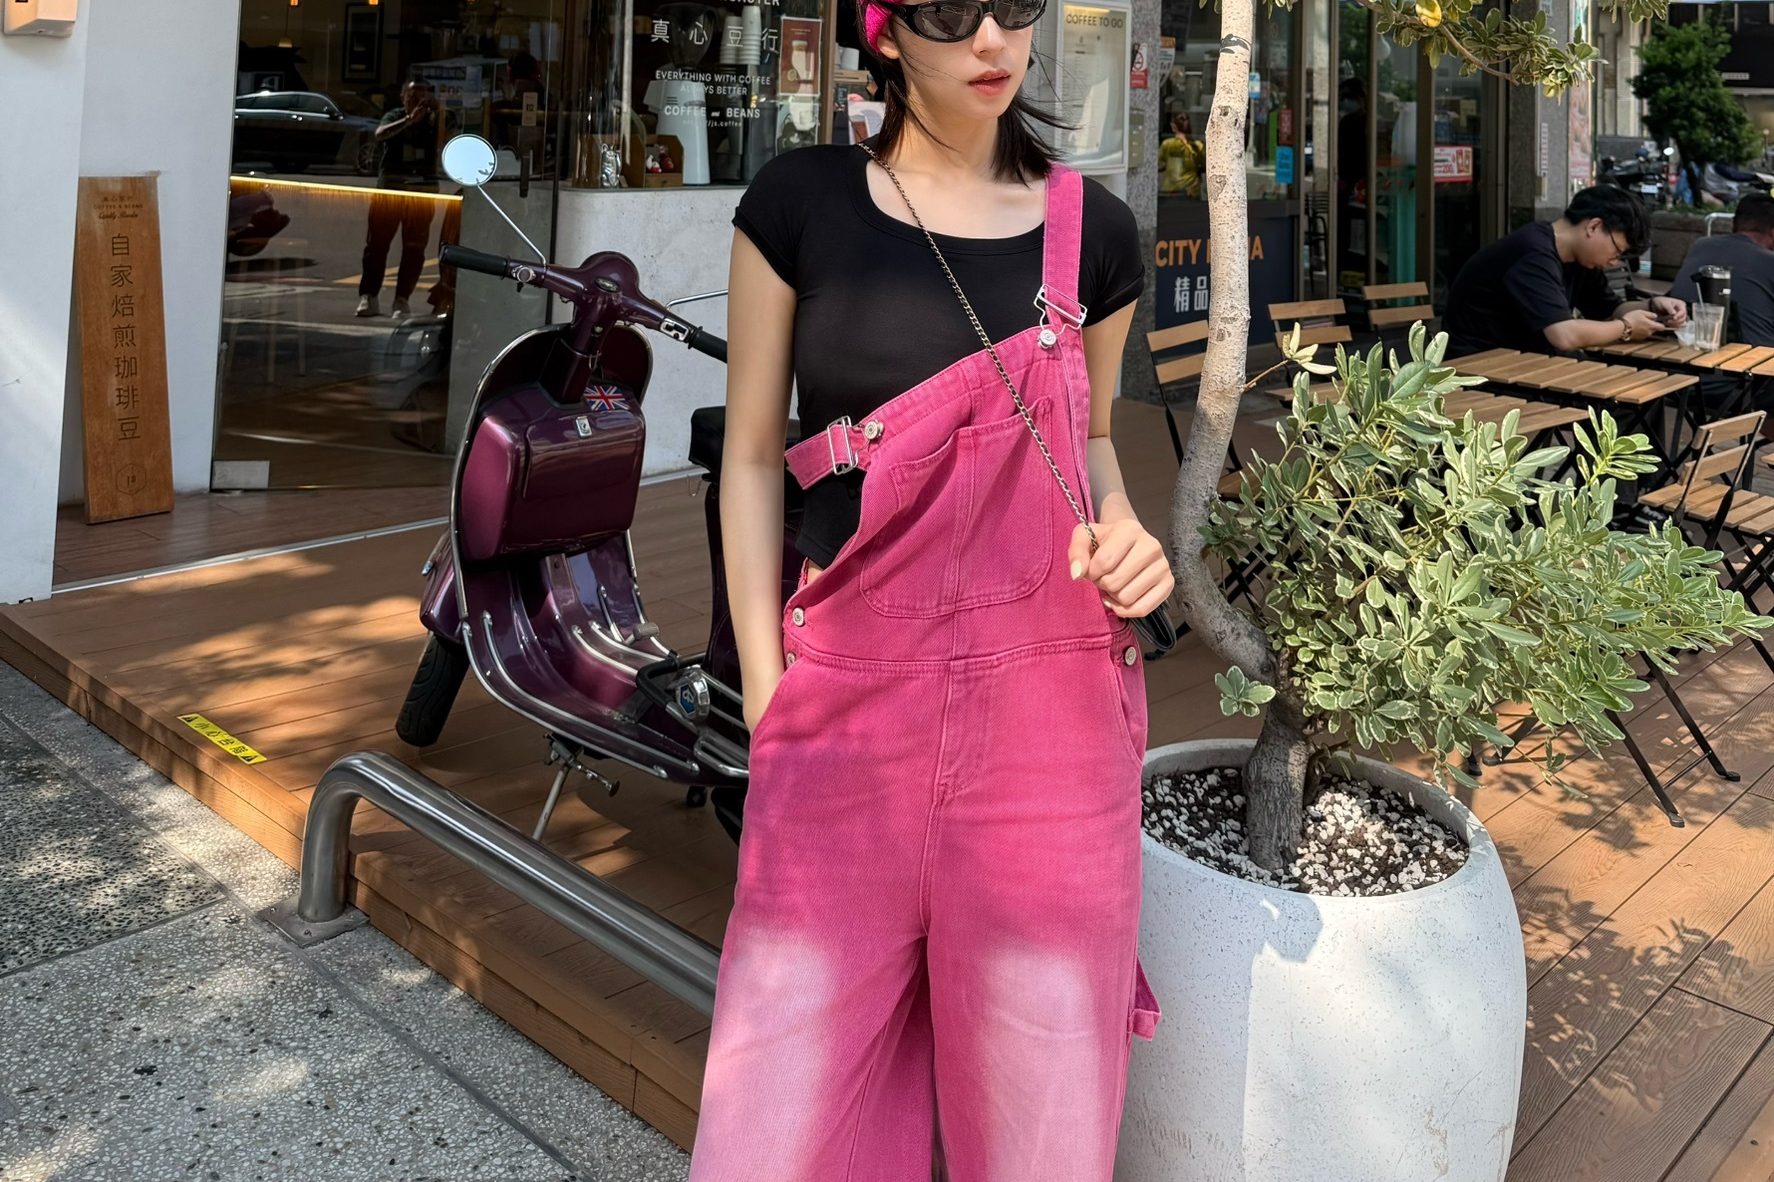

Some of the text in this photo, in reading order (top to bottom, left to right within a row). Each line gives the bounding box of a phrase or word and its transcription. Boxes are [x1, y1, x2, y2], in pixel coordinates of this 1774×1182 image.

[1066, 13, 1124, 29] COFFEE TO GO
[655, 70, 771, 85] EVERYTHING WITH COFFEE
[717, 85, 748, 95] BETTER
[664, 105, 707, 117] COFFEE
[726, 107, 761, 118] BEANS
[1155, 238, 1202, 267] CITY
